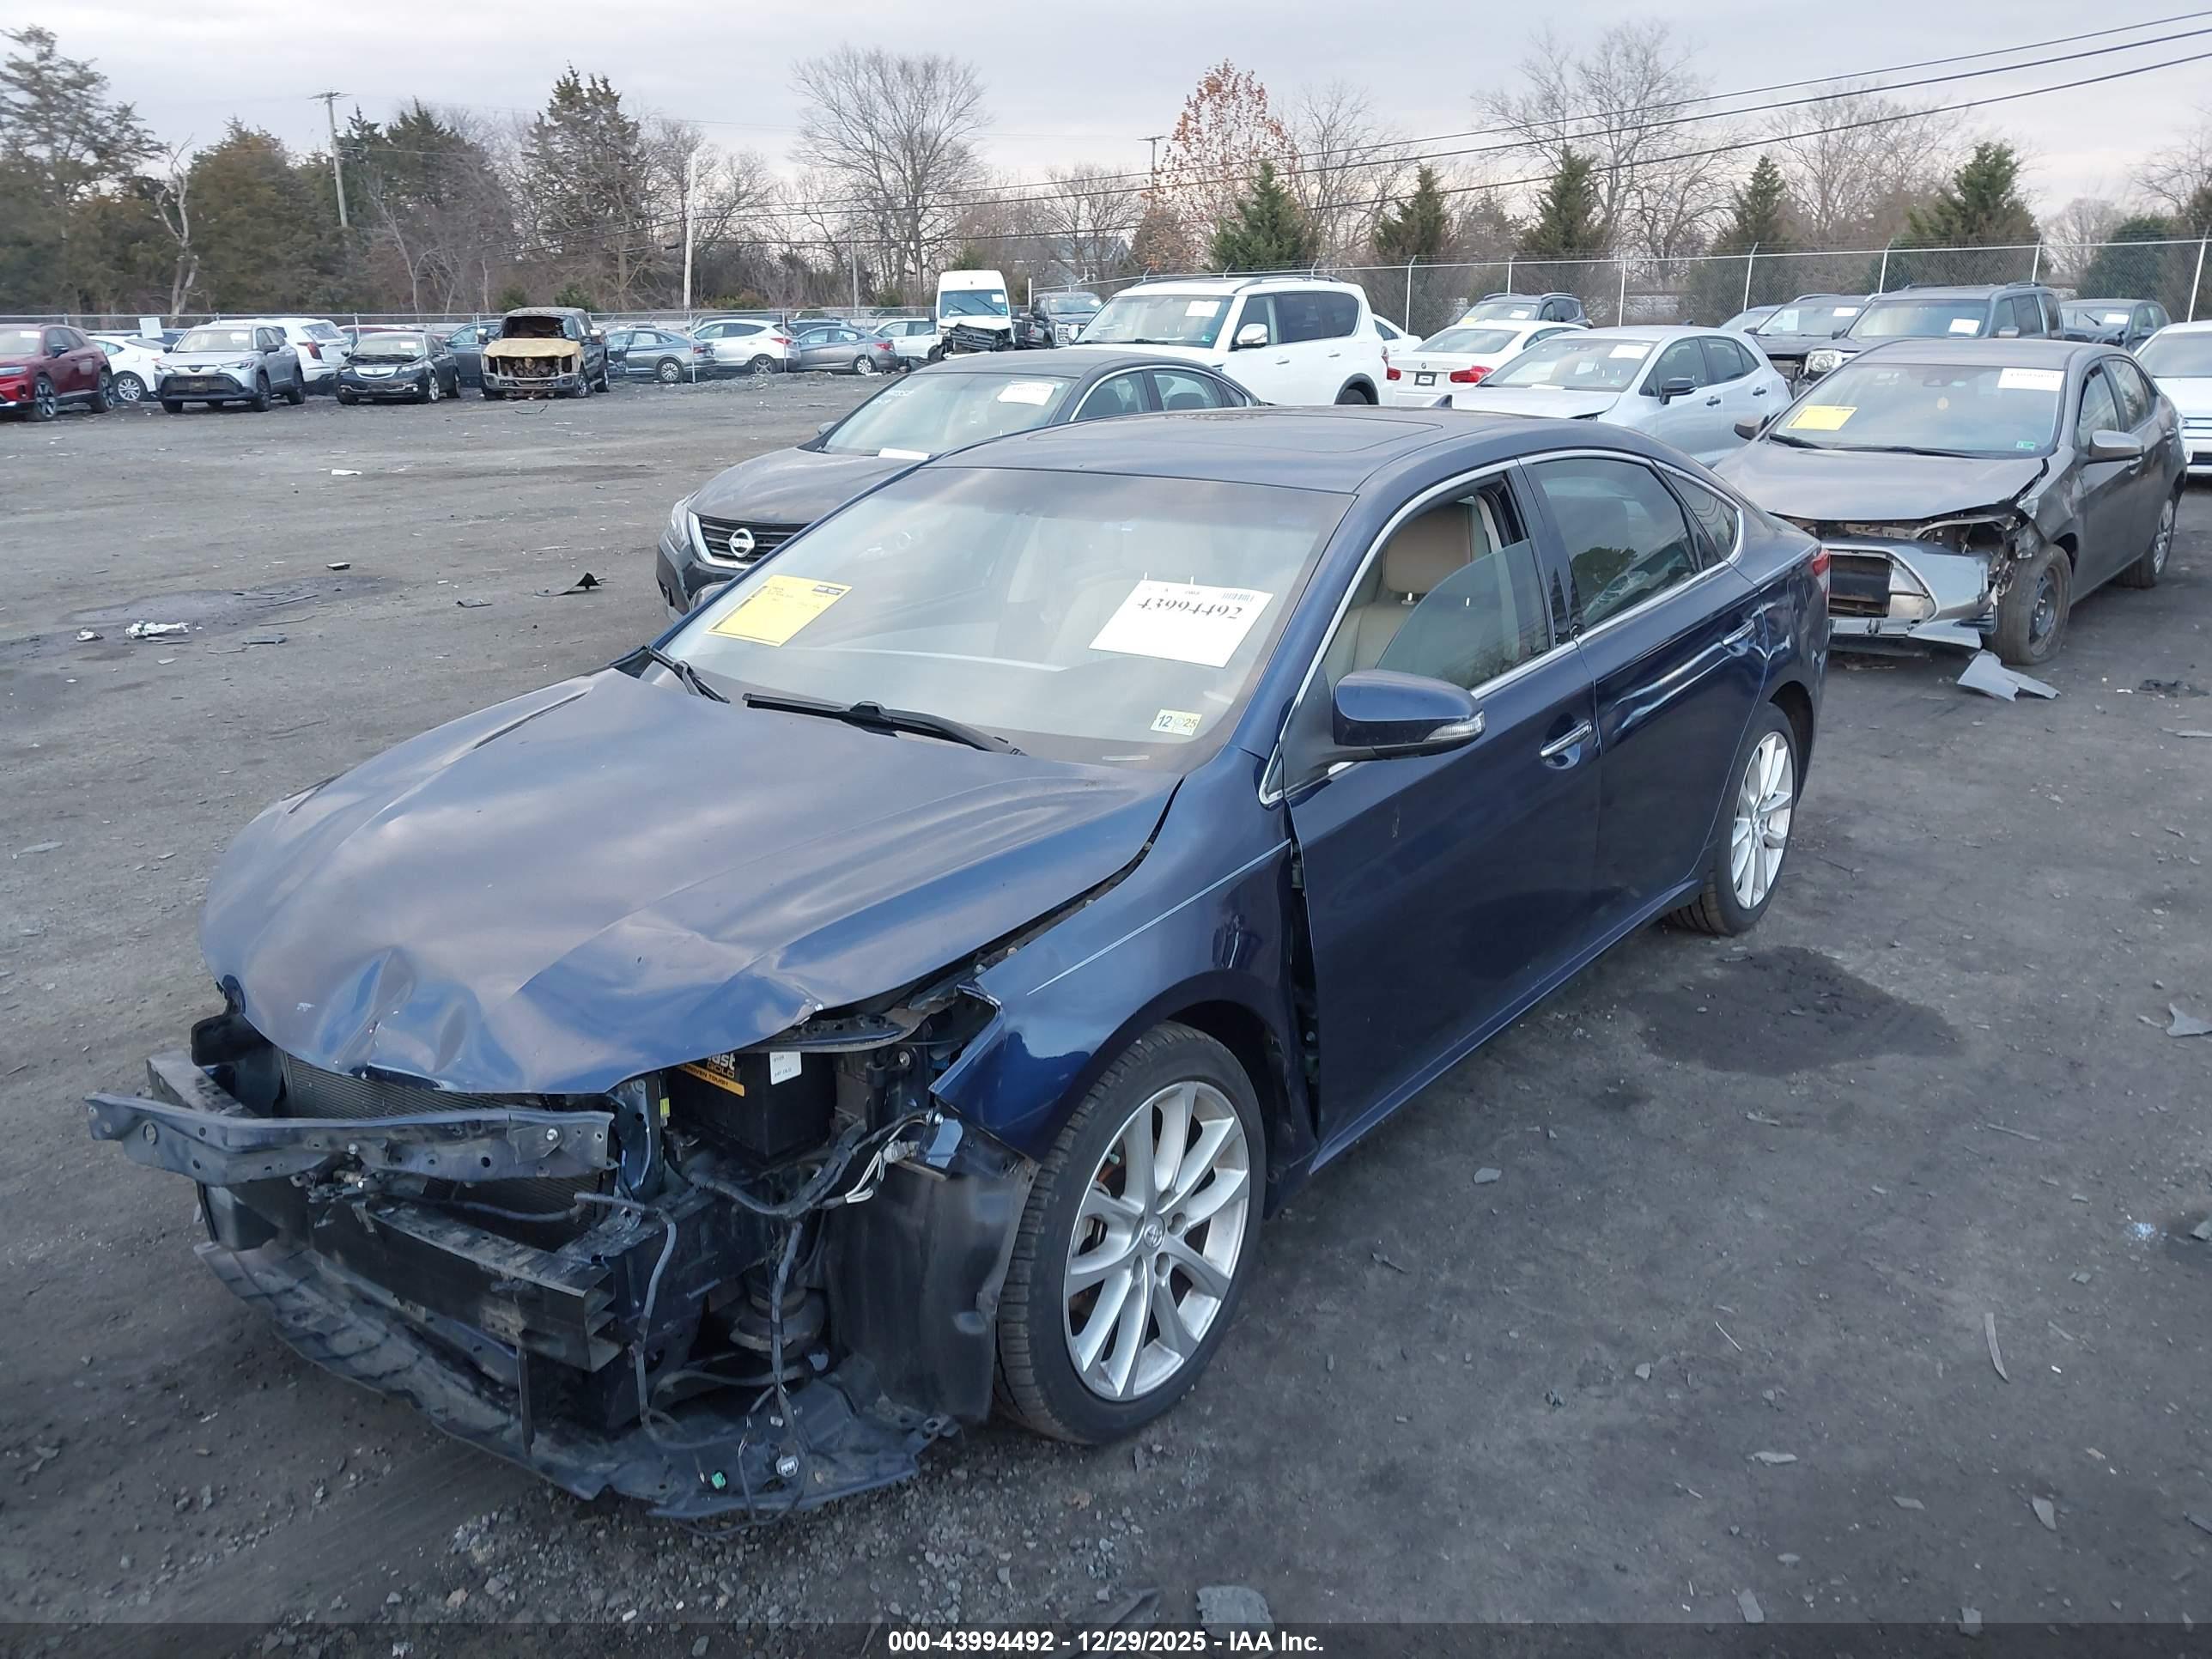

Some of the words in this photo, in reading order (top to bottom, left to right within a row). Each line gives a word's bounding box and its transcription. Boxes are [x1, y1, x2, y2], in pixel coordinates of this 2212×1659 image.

[1137, 597, 1243, 619] 43994492
[1158, 714, 1173, 727] 12
[1182, 718, 1199, 728] 25
[707, 1061, 735, 1079] GOLD
